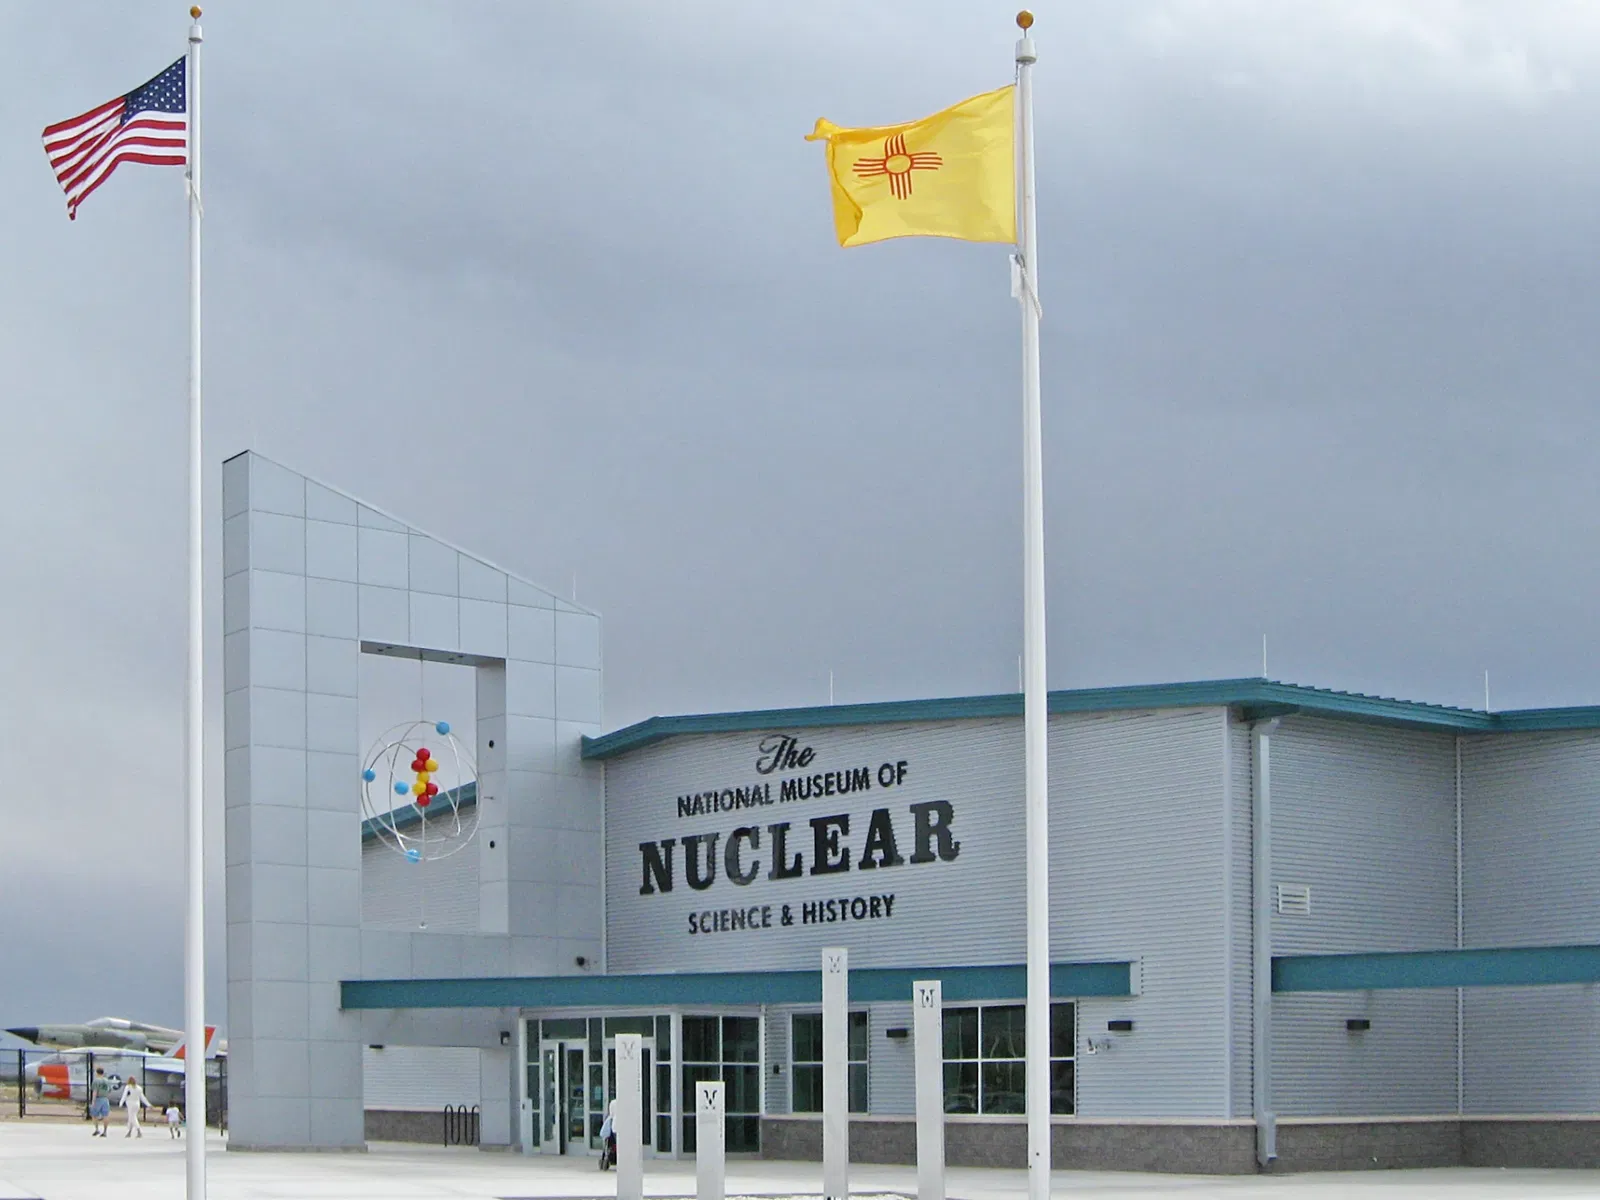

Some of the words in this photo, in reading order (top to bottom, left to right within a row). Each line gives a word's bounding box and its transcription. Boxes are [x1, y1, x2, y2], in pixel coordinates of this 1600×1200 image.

[756, 734, 815, 774] The
[677, 783, 774, 817] NATIONAL
[780, 767, 869, 802] MUSEUM
[878, 761, 908, 787] OF
[639, 800, 960, 895] NUCLEAR
[688, 905, 772, 934] SCIENCE
[781, 905, 793, 925] &
[802, 894, 895, 924] HISTORY
